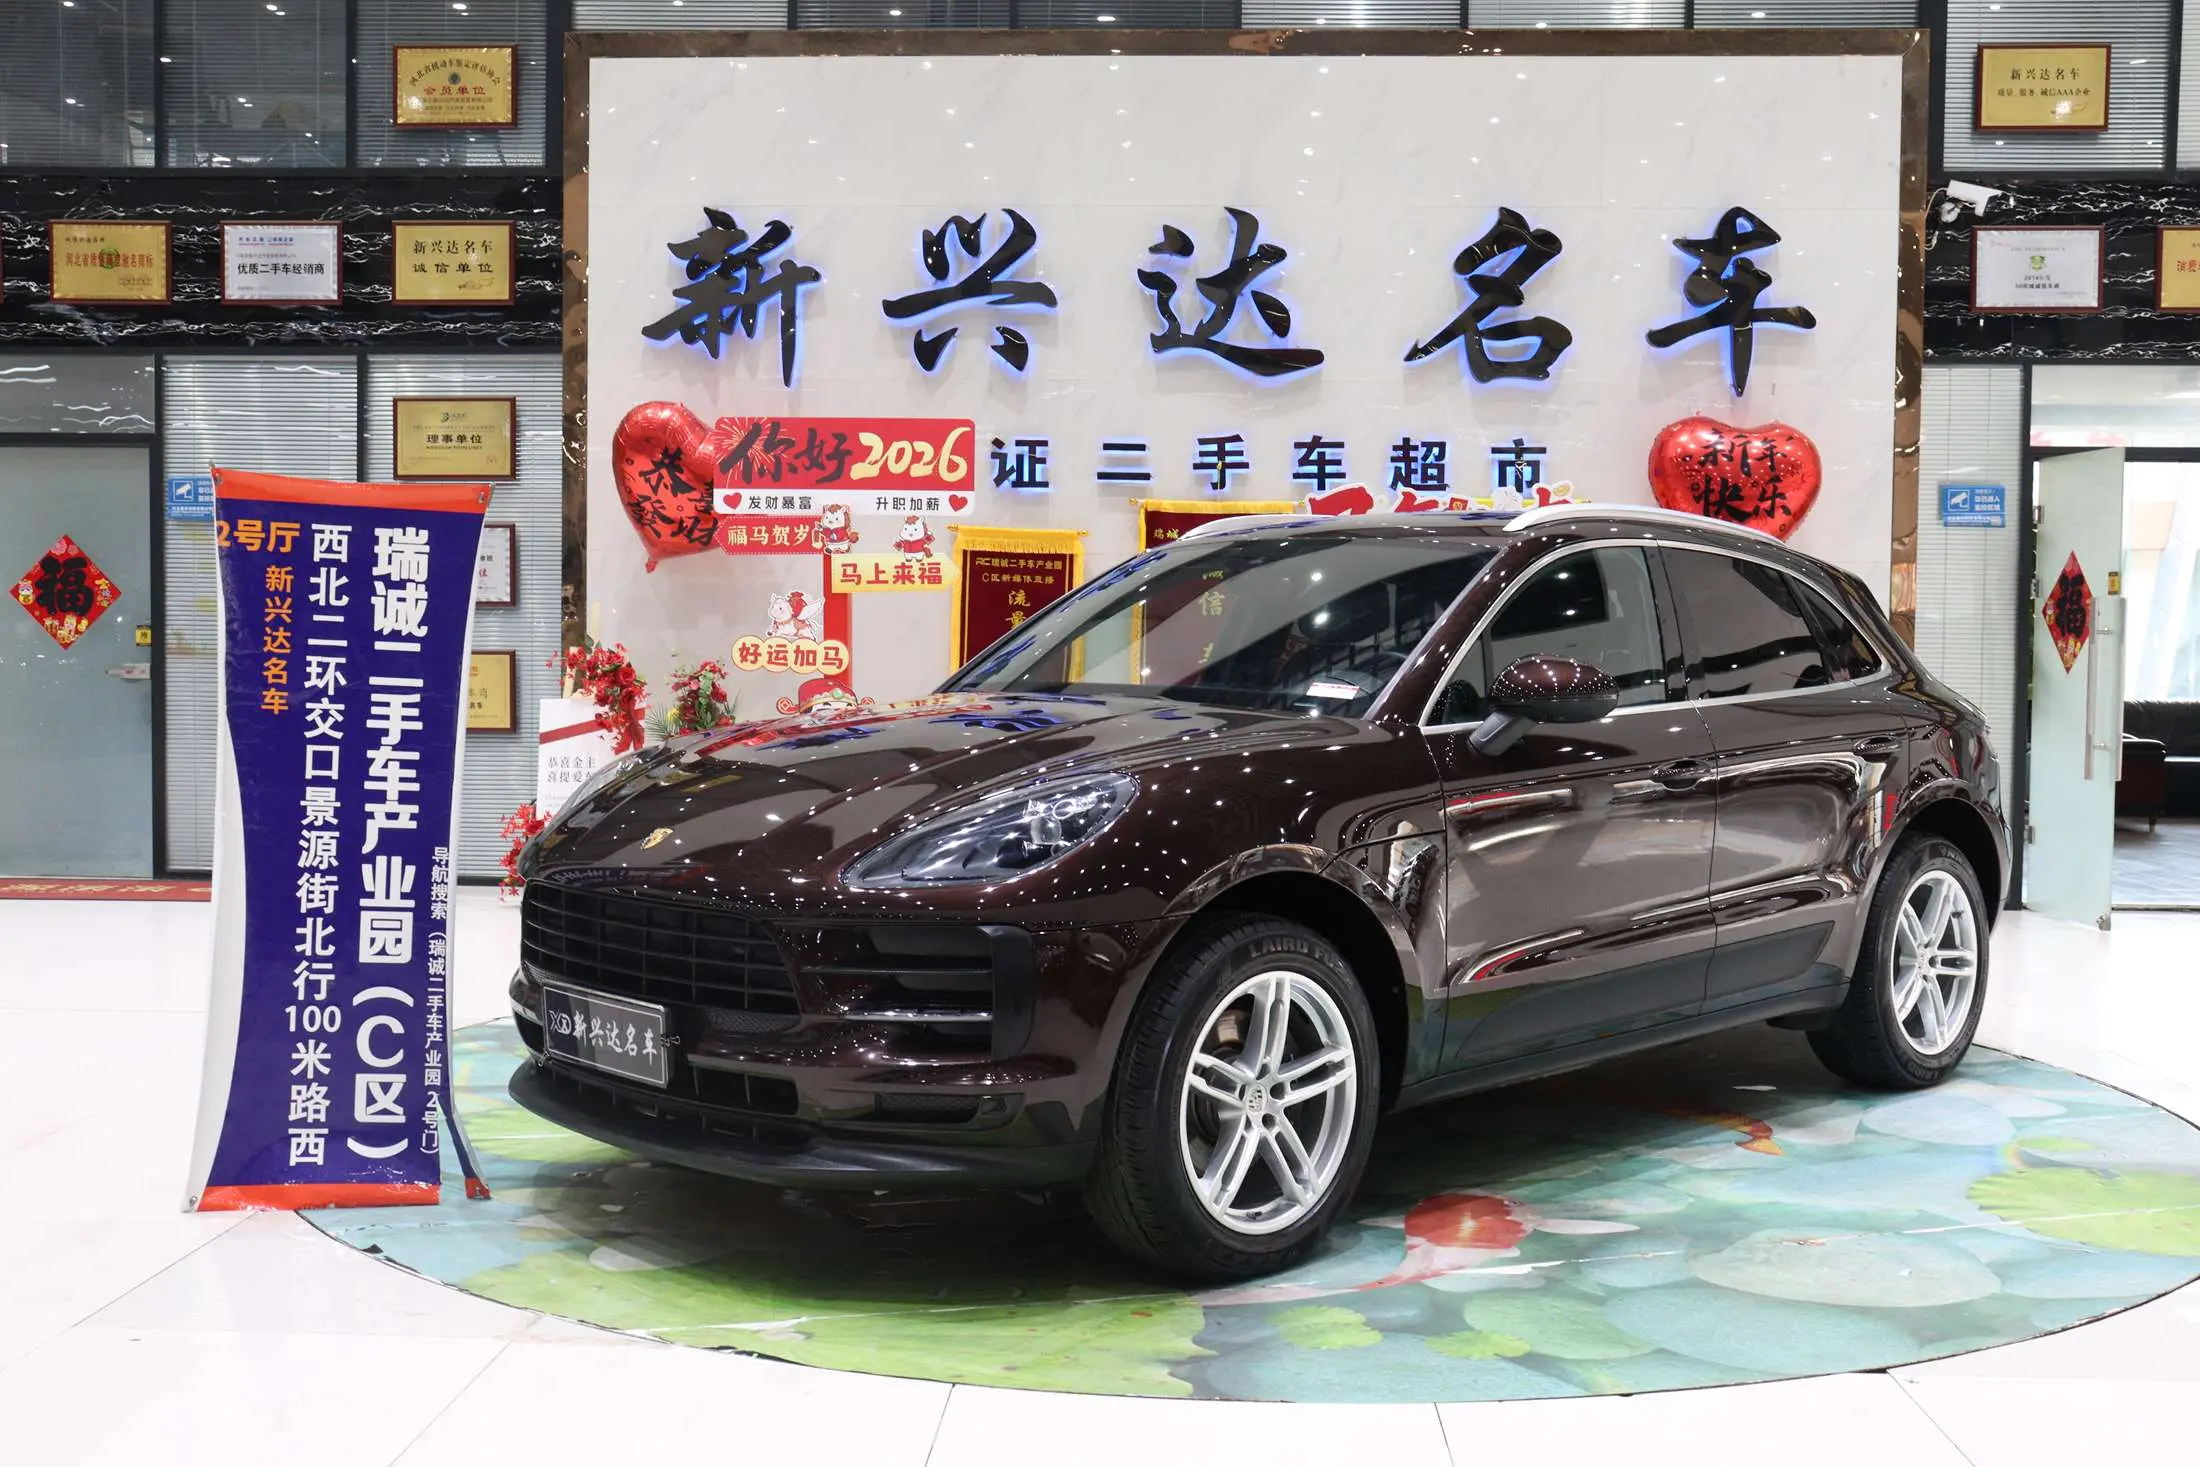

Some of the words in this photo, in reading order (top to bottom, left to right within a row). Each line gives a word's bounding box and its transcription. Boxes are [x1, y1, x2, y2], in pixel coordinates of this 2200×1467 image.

[2011, 68, 2080, 80] 新兴达名车
[414, 240, 493, 254] 新兴达名车
[237, 263, 325, 275] 优质二手车经销商
[412, 262, 494, 273] 诚信单位
[641, 206, 1817, 397] 新兴达名车
[427, 434, 482, 444] 理事单位
[990, 433, 1547, 492] 证二手车超市
[748, 495, 812, 510] 发财暴富
[875, 496, 940, 511] 升职加薪
[217, 519, 301, 553] 2号厅
[727, 524, 811, 547] 福马贺岁
[36, 556, 94, 616] 福
[840, 562, 943, 587] 马上来福
[260, 564, 294, 714] 新兴达名车
[739, 641, 843, 669] 好运加马
[572, 1010, 658, 1066] 新兴达名车
